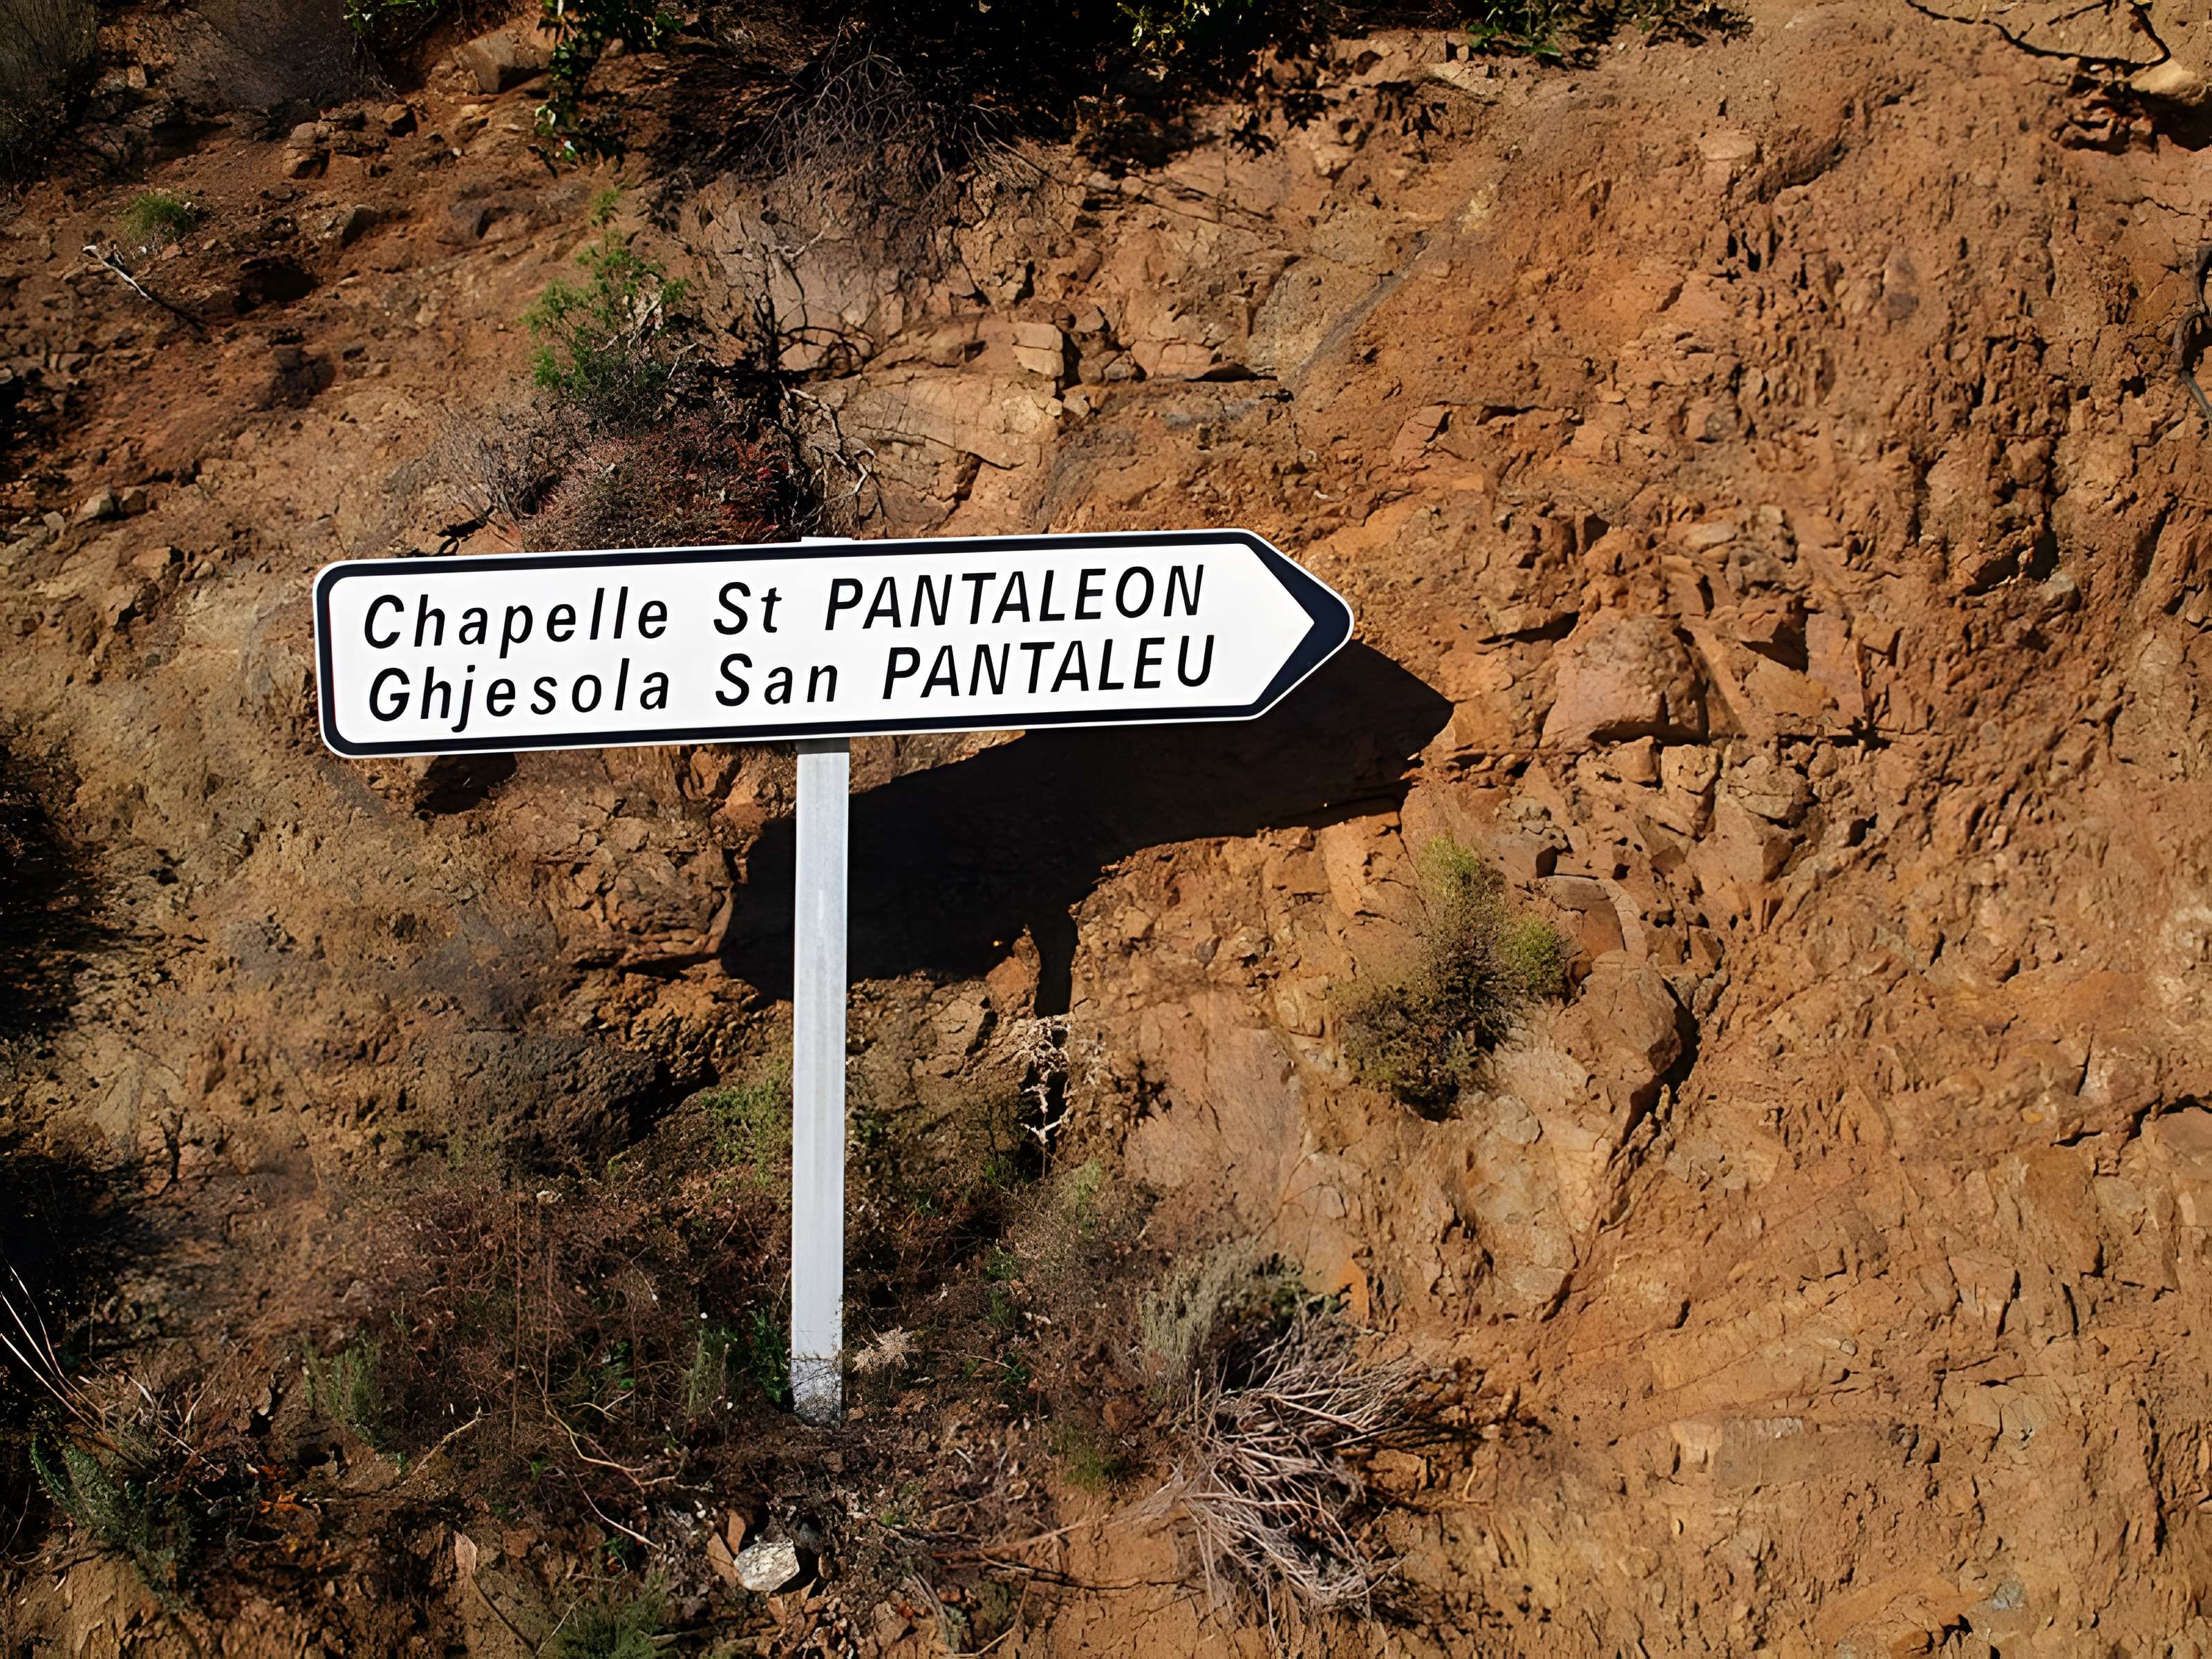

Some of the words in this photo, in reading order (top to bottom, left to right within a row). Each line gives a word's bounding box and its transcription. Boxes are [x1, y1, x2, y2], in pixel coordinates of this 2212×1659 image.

[364, 585, 668, 659] Chapelle
[713, 581, 782, 635] St
[825, 564, 1204, 631] PANTALEON
[369, 657, 669, 733] Ghjesola
[715, 653, 838, 706] San
[882, 635, 1215, 700] PANTALEU
